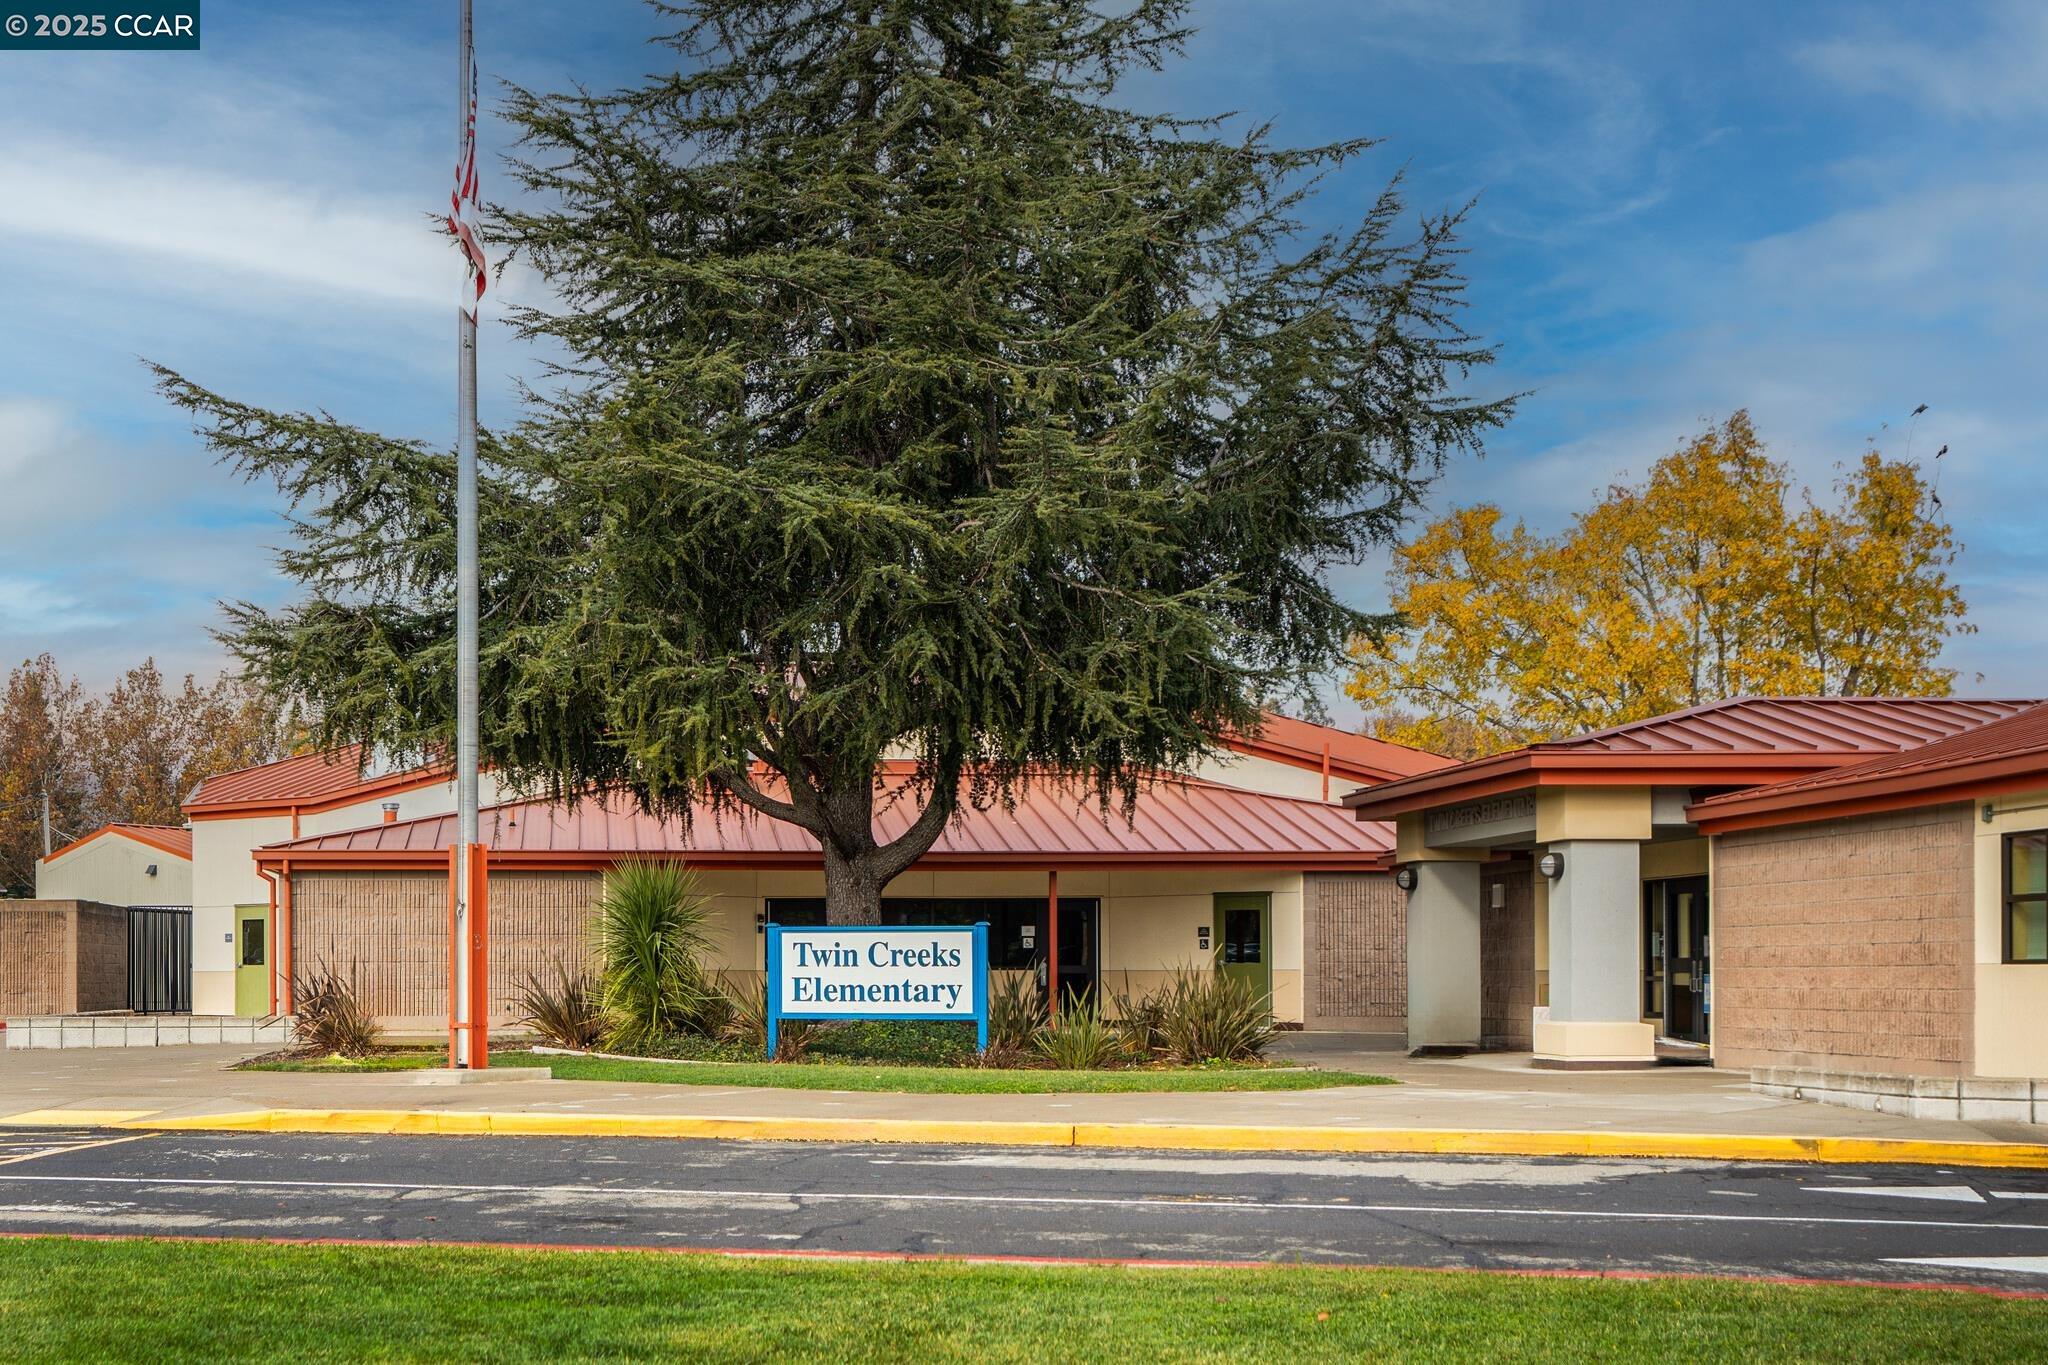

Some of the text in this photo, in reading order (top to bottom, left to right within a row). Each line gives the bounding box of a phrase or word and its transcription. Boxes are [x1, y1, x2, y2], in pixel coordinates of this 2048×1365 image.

[793, 941, 961, 968] Twin Creeks
[791, 977, 963, 1009] Elementary
